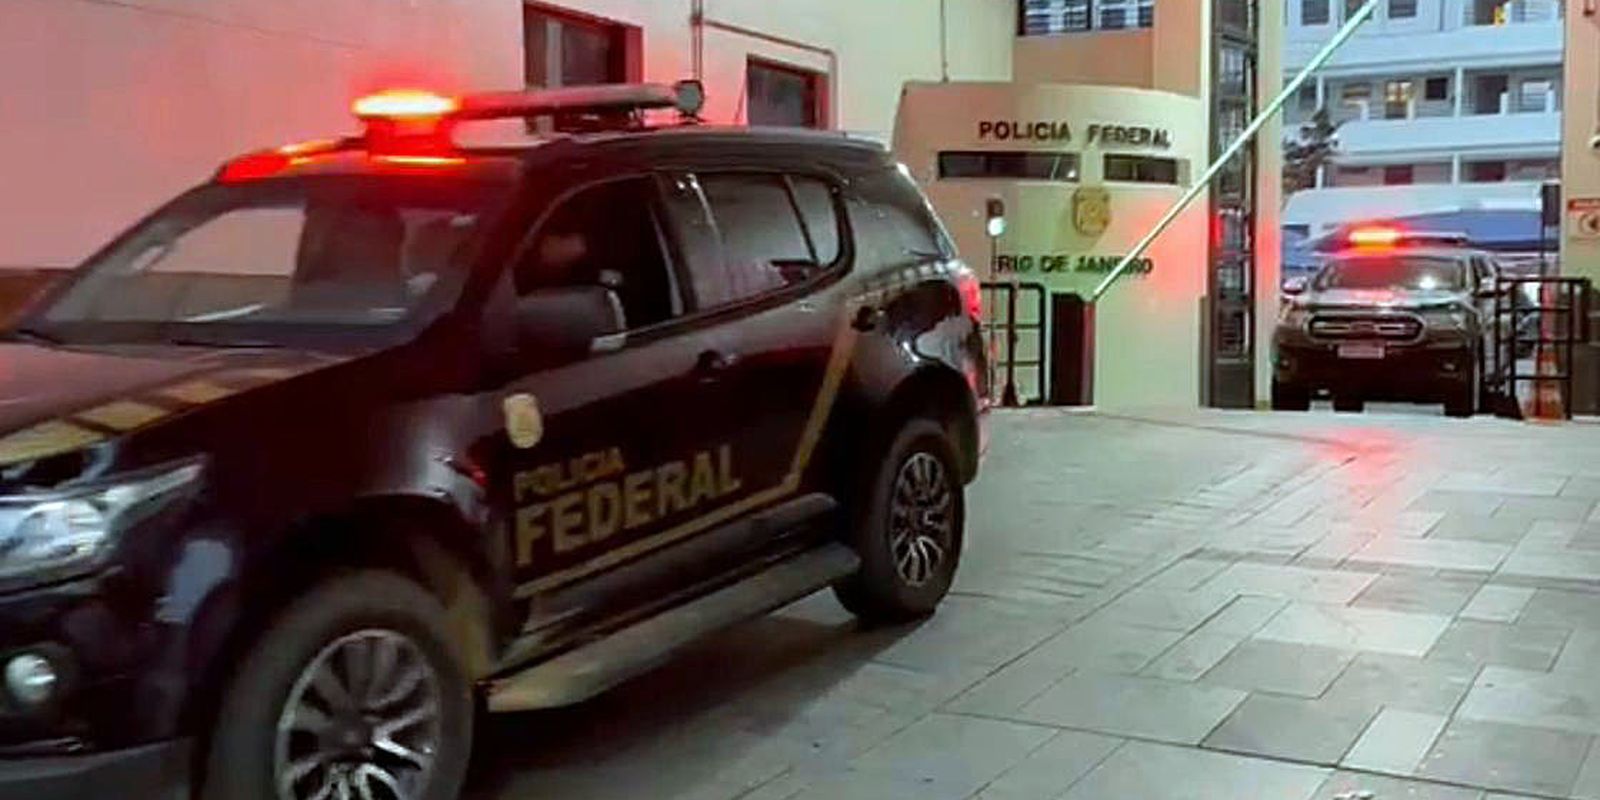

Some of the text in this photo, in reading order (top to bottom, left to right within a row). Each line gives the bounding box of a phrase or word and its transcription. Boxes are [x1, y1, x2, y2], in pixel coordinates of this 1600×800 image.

[979, 121, 1170, 148] POLICIA FEDERAL
[997, 255, 1034, 273] RIO
[1040, 255, 1069, 273] DE
[513, 446, 624, 502] POLICIA
[516, 444, 742, 567] FEDERAL
